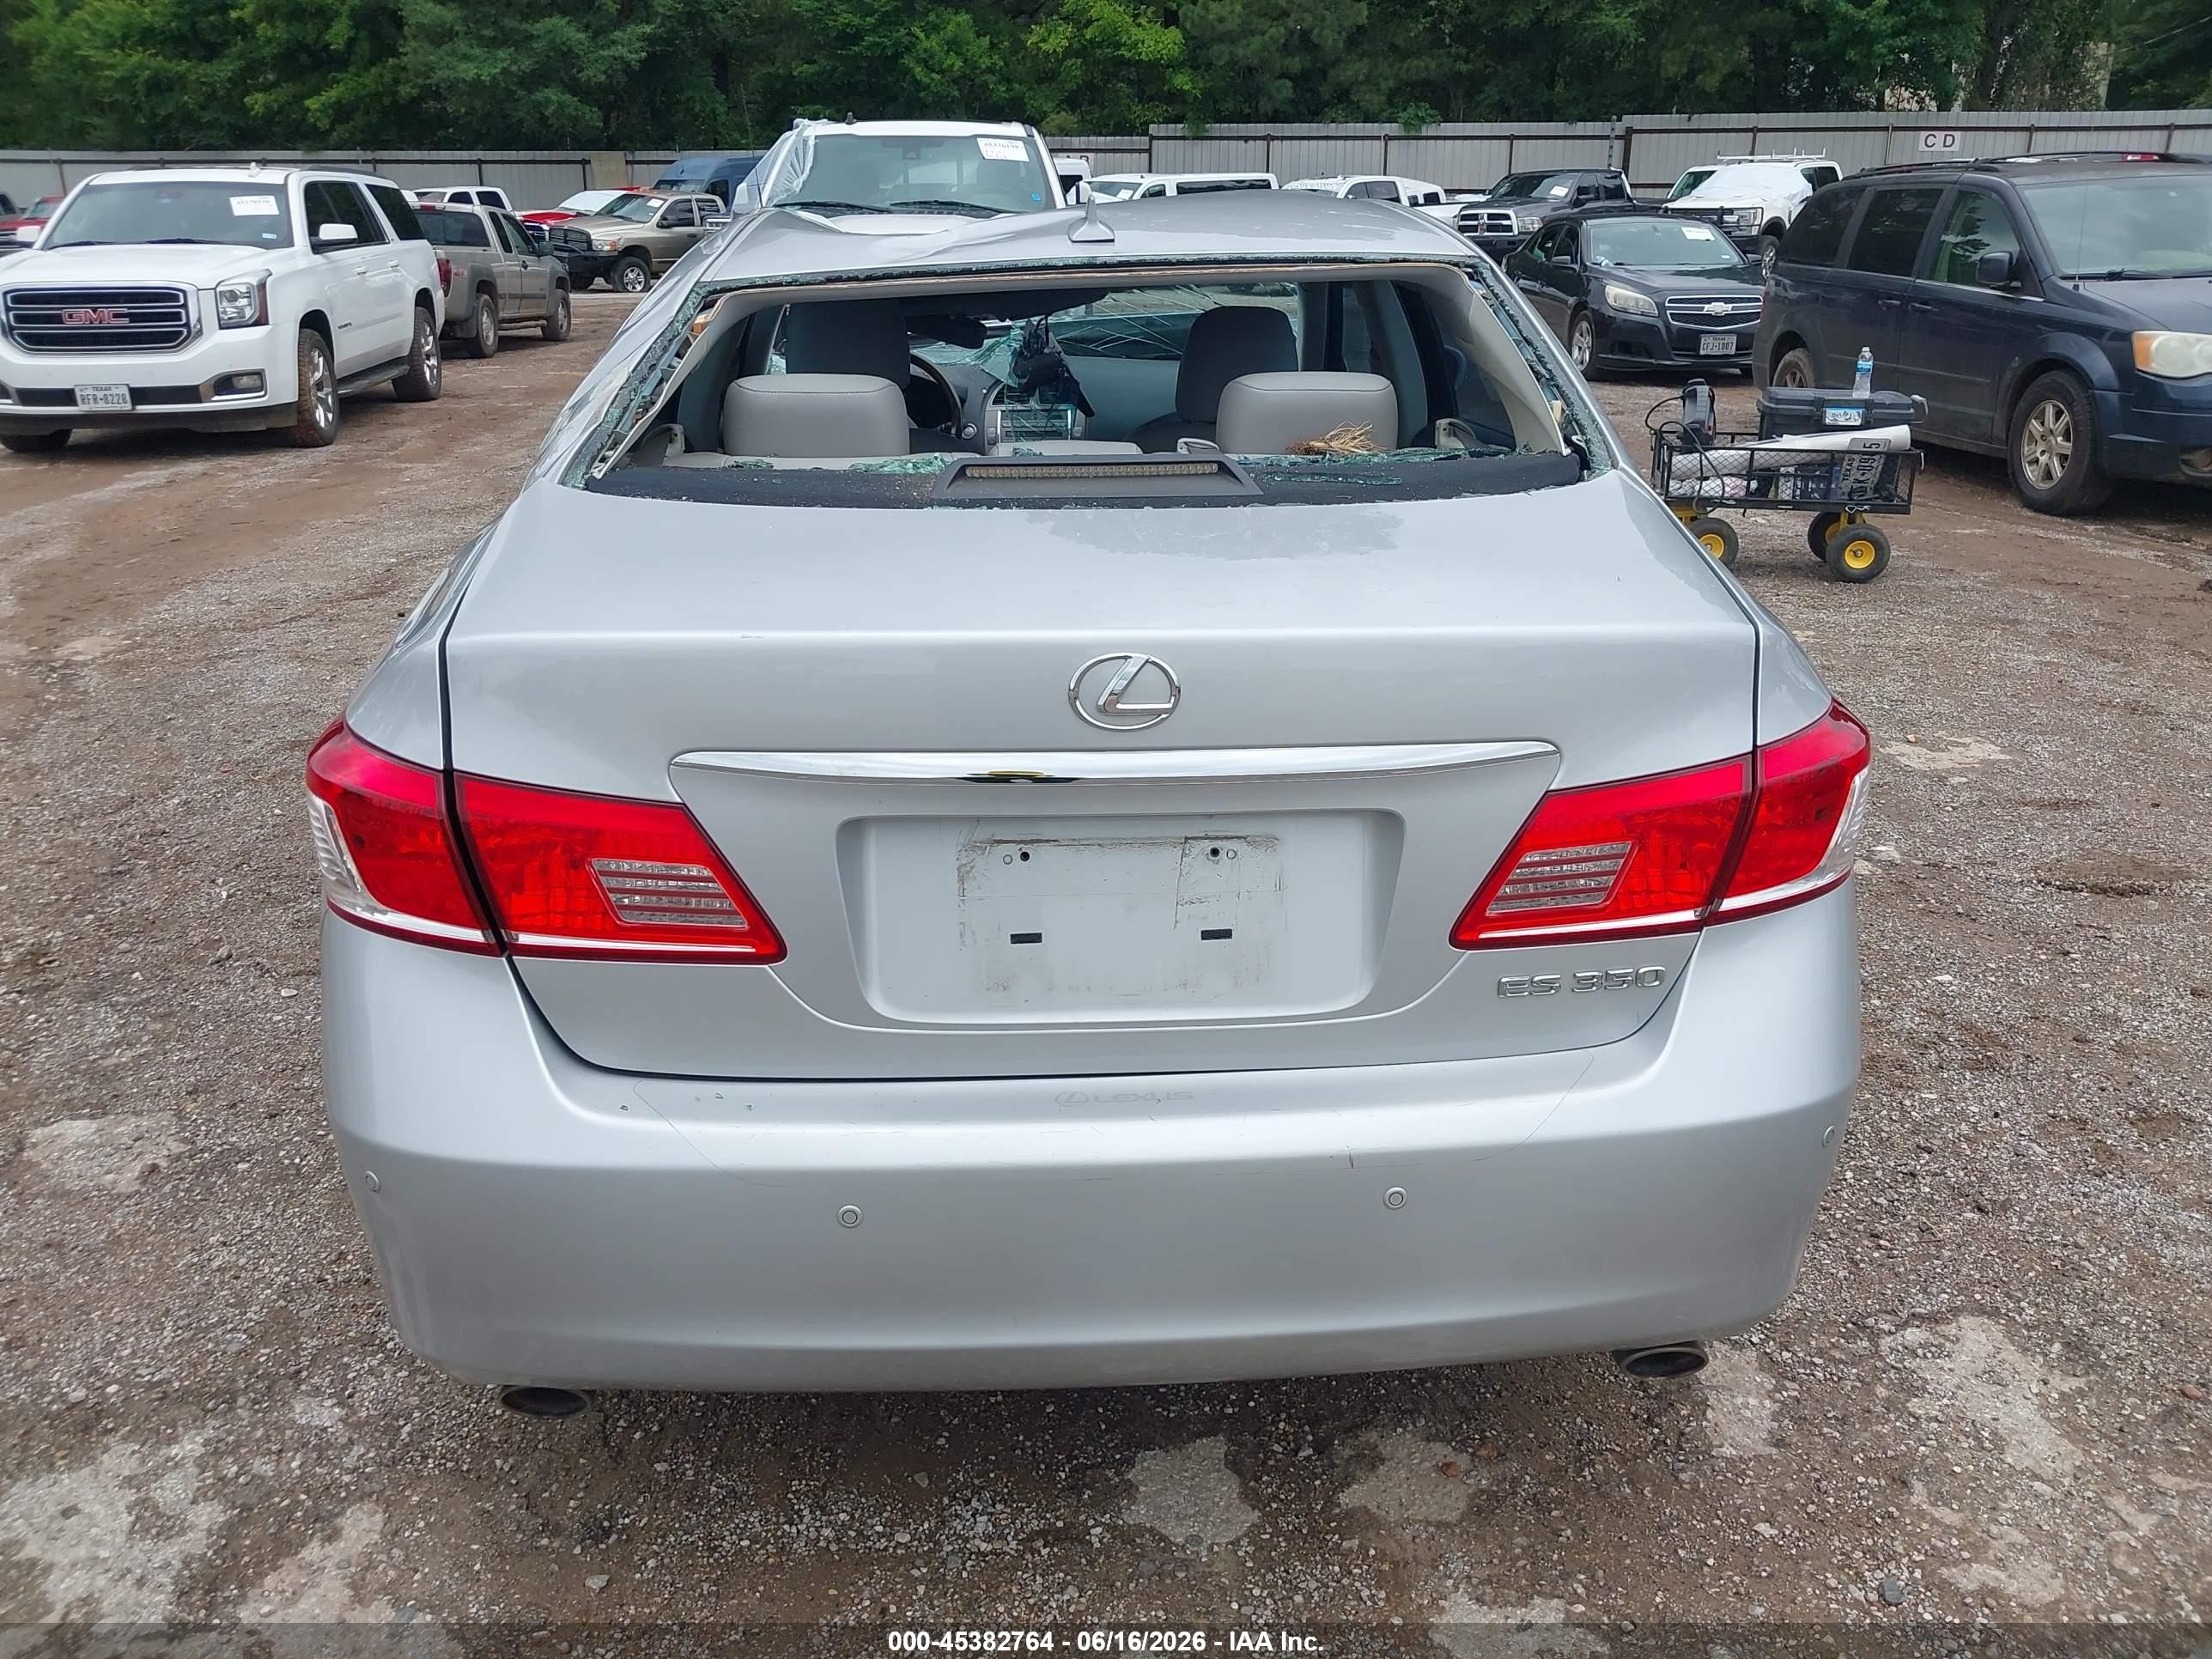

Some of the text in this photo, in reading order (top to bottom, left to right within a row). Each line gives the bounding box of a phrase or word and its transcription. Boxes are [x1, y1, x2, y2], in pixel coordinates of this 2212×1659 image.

[1923, 133, 1956, 149] C D
[62, 308, 131, 325] GMC
[1841, 457, 1856, 483] TEXAS
[1497, 964, 1667, 998] ES 350
[1093, 1091, 1195, 1103] LEXUS
